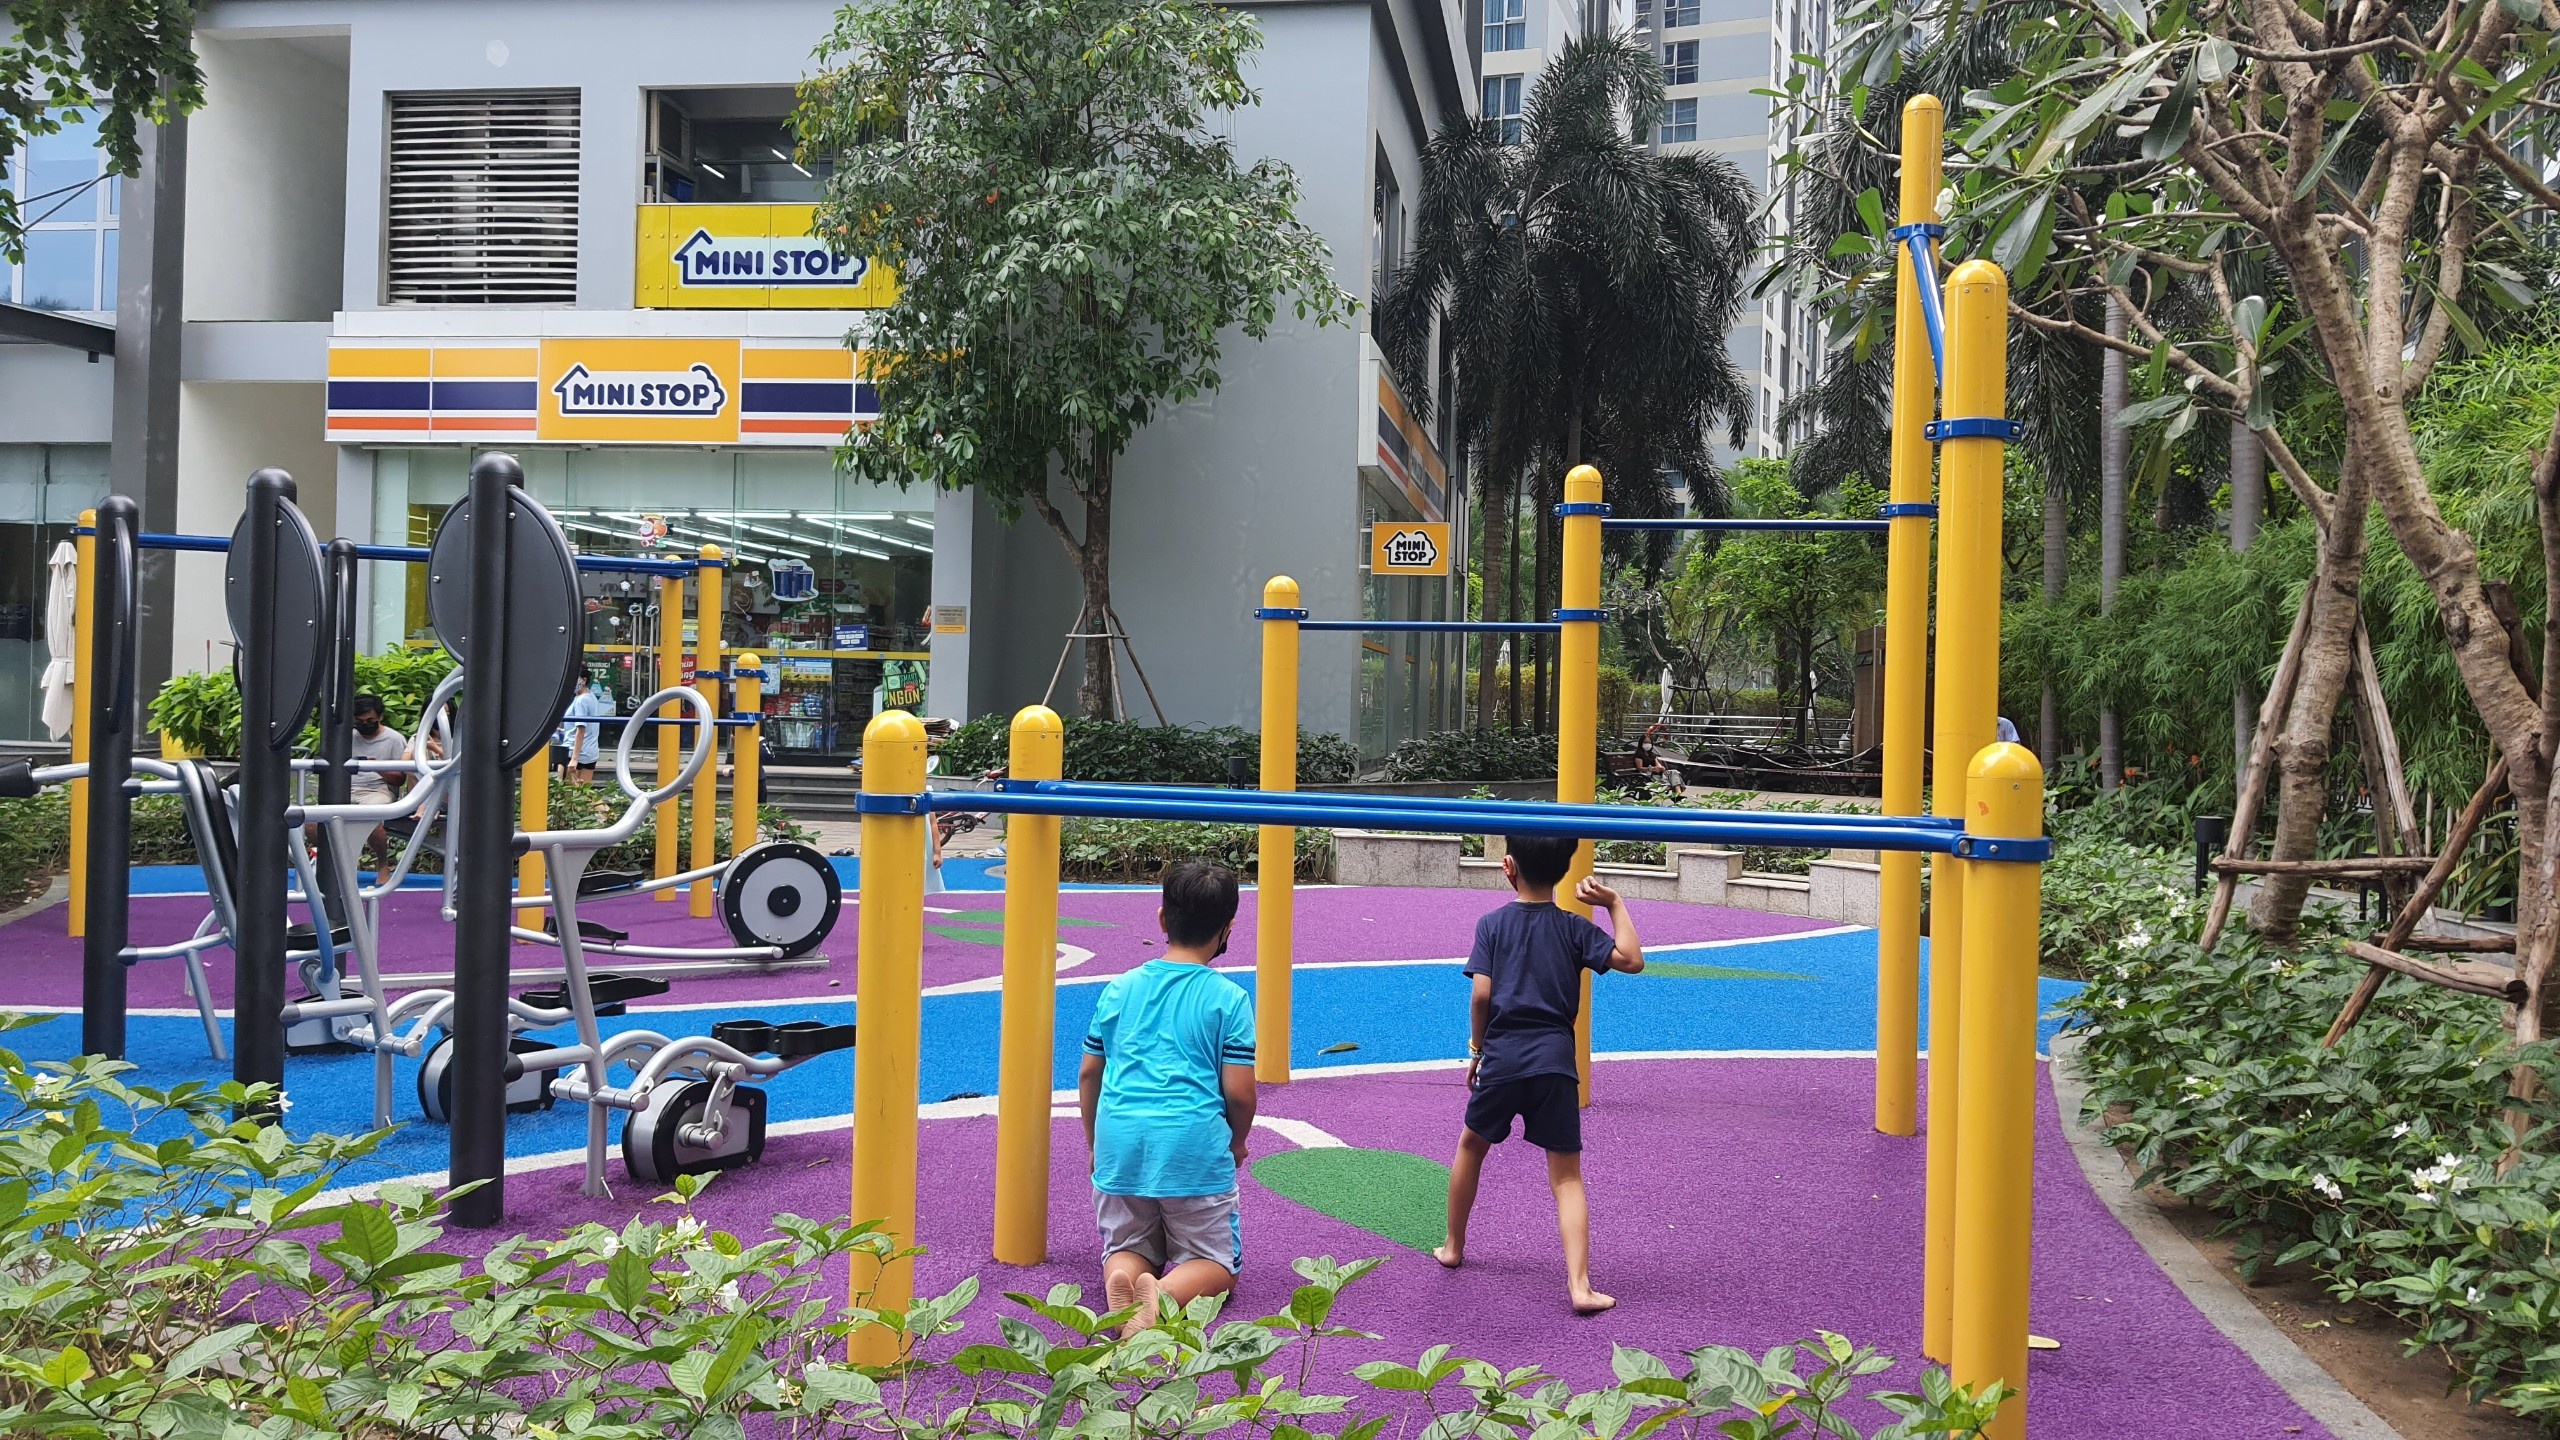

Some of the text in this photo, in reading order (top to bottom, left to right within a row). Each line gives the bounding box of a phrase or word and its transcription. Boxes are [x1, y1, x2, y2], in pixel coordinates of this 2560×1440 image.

[695, 249, 851, 276] MINI STOP
[573, 383, 710, 407] MINI STOP
[1396, 540, 1426, 551] MINI
[1394, 551, 1427, 562] STOP
